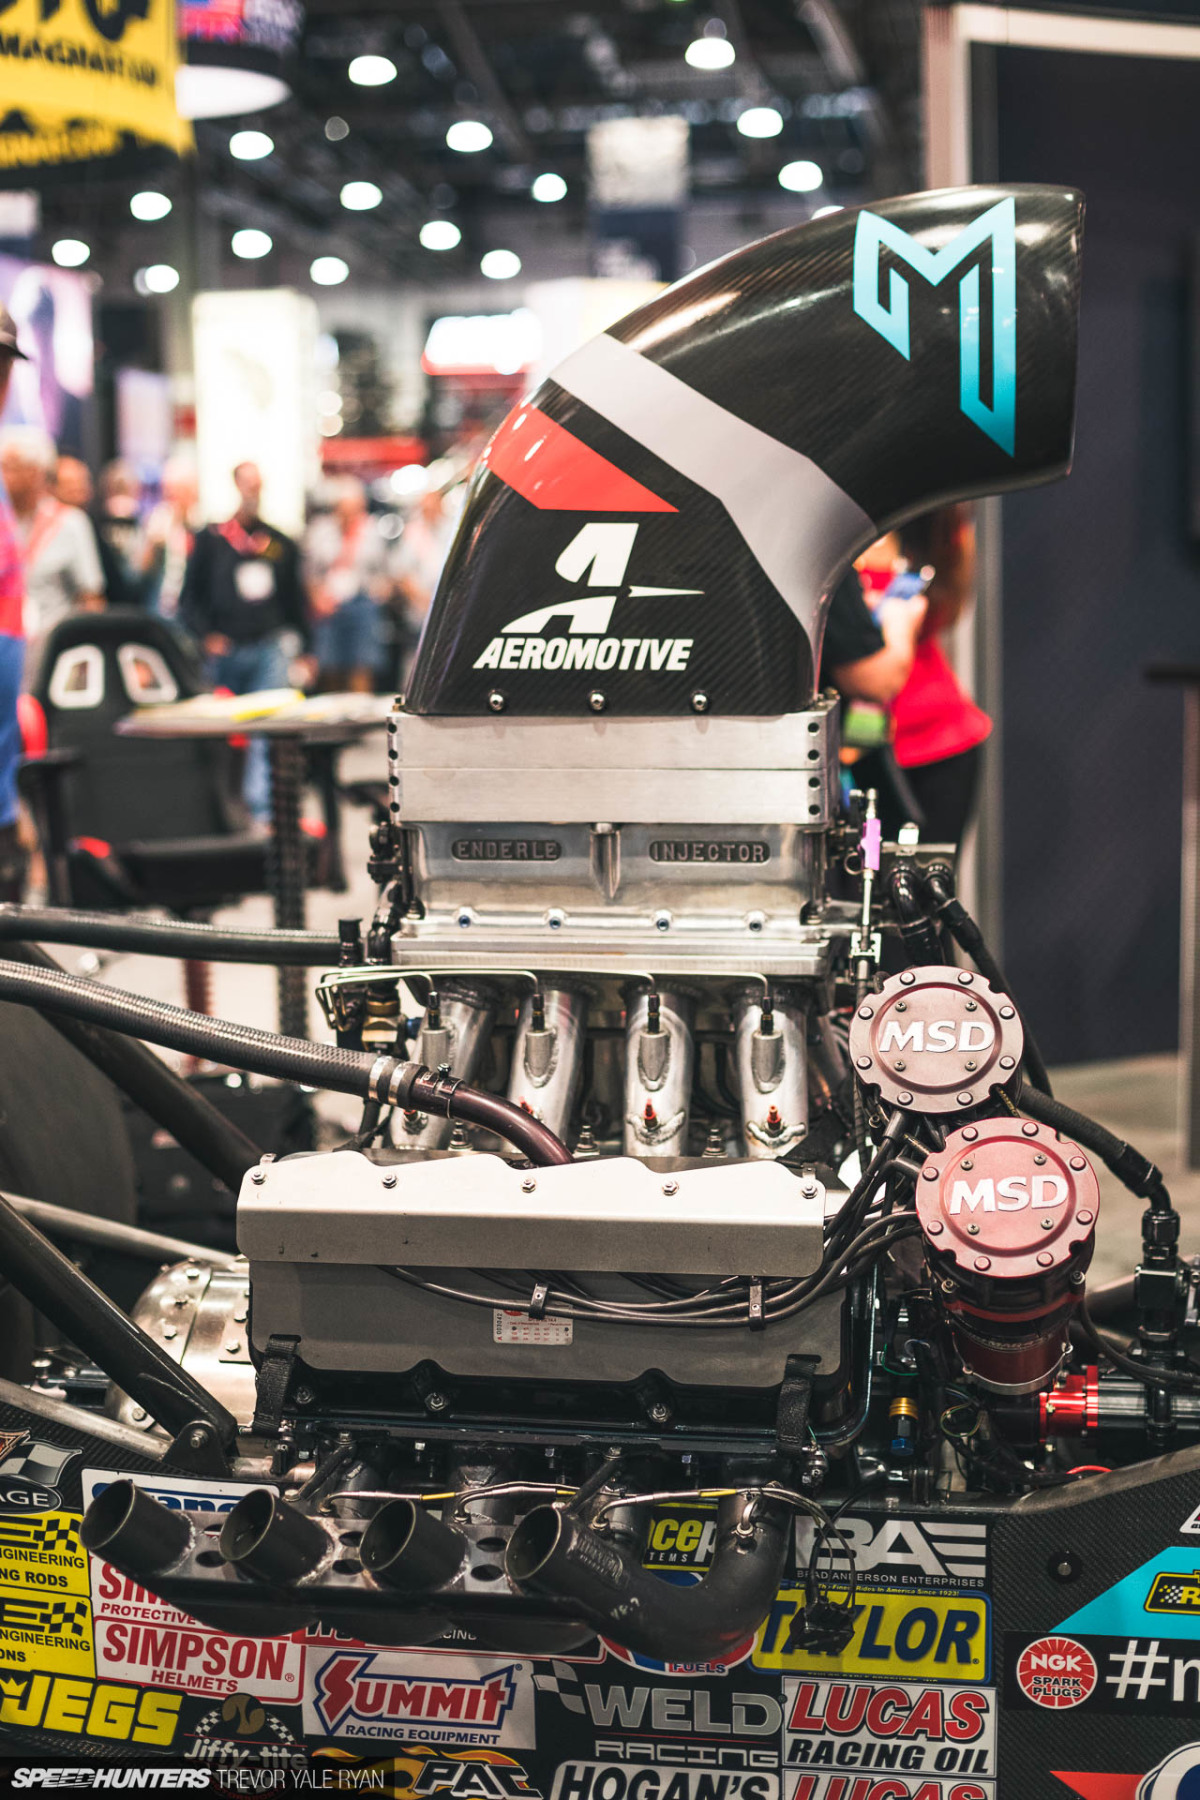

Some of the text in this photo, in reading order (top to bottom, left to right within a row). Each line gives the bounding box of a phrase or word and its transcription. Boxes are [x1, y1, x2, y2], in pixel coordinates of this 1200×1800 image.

[473, 637, 694, 671] AEROMOTIVE
[457, 840, 765, 862] ENDERLE INJECTOR
[879, 1020, 995, 1053] MSD
[949, 1175, 1069, 1216] MSD
[0, 1490, 50, 1508] GE
[0, 1548, 85, 1569] GINEERING
[649, 1551, 689, 1563] TEMS
[25, 1571, 68, 1588] RODS
[832, 1572, 897, 1583] ANERSON
[902, 1576, 985, 1588] ENTERPRISES
[760, 1600, 980, 1665] TLOR
[103, 1623, 288, 1681] SIMPSON
[1031, 1654, 1082, 1672] NGK
[673, 1662, 727, 1674] FUELS
[151, 1669, 239, 1694] HELMETS
[1033, 1676, 1081, 1687] SPARK
[1033, 1687, 1081, 1697] PLUGS
[0, 1674, 184, 1746] JEGS
[584, 1684, 783, 1735] WELD
[789, 1683, 988, 1741] LUCAS
[346, 1724, 501, 1746] RACING EQUIPMENT
[594, 1740, 779, 1768] RACING
[786, 1738, 990, 1774] RACING OIL
